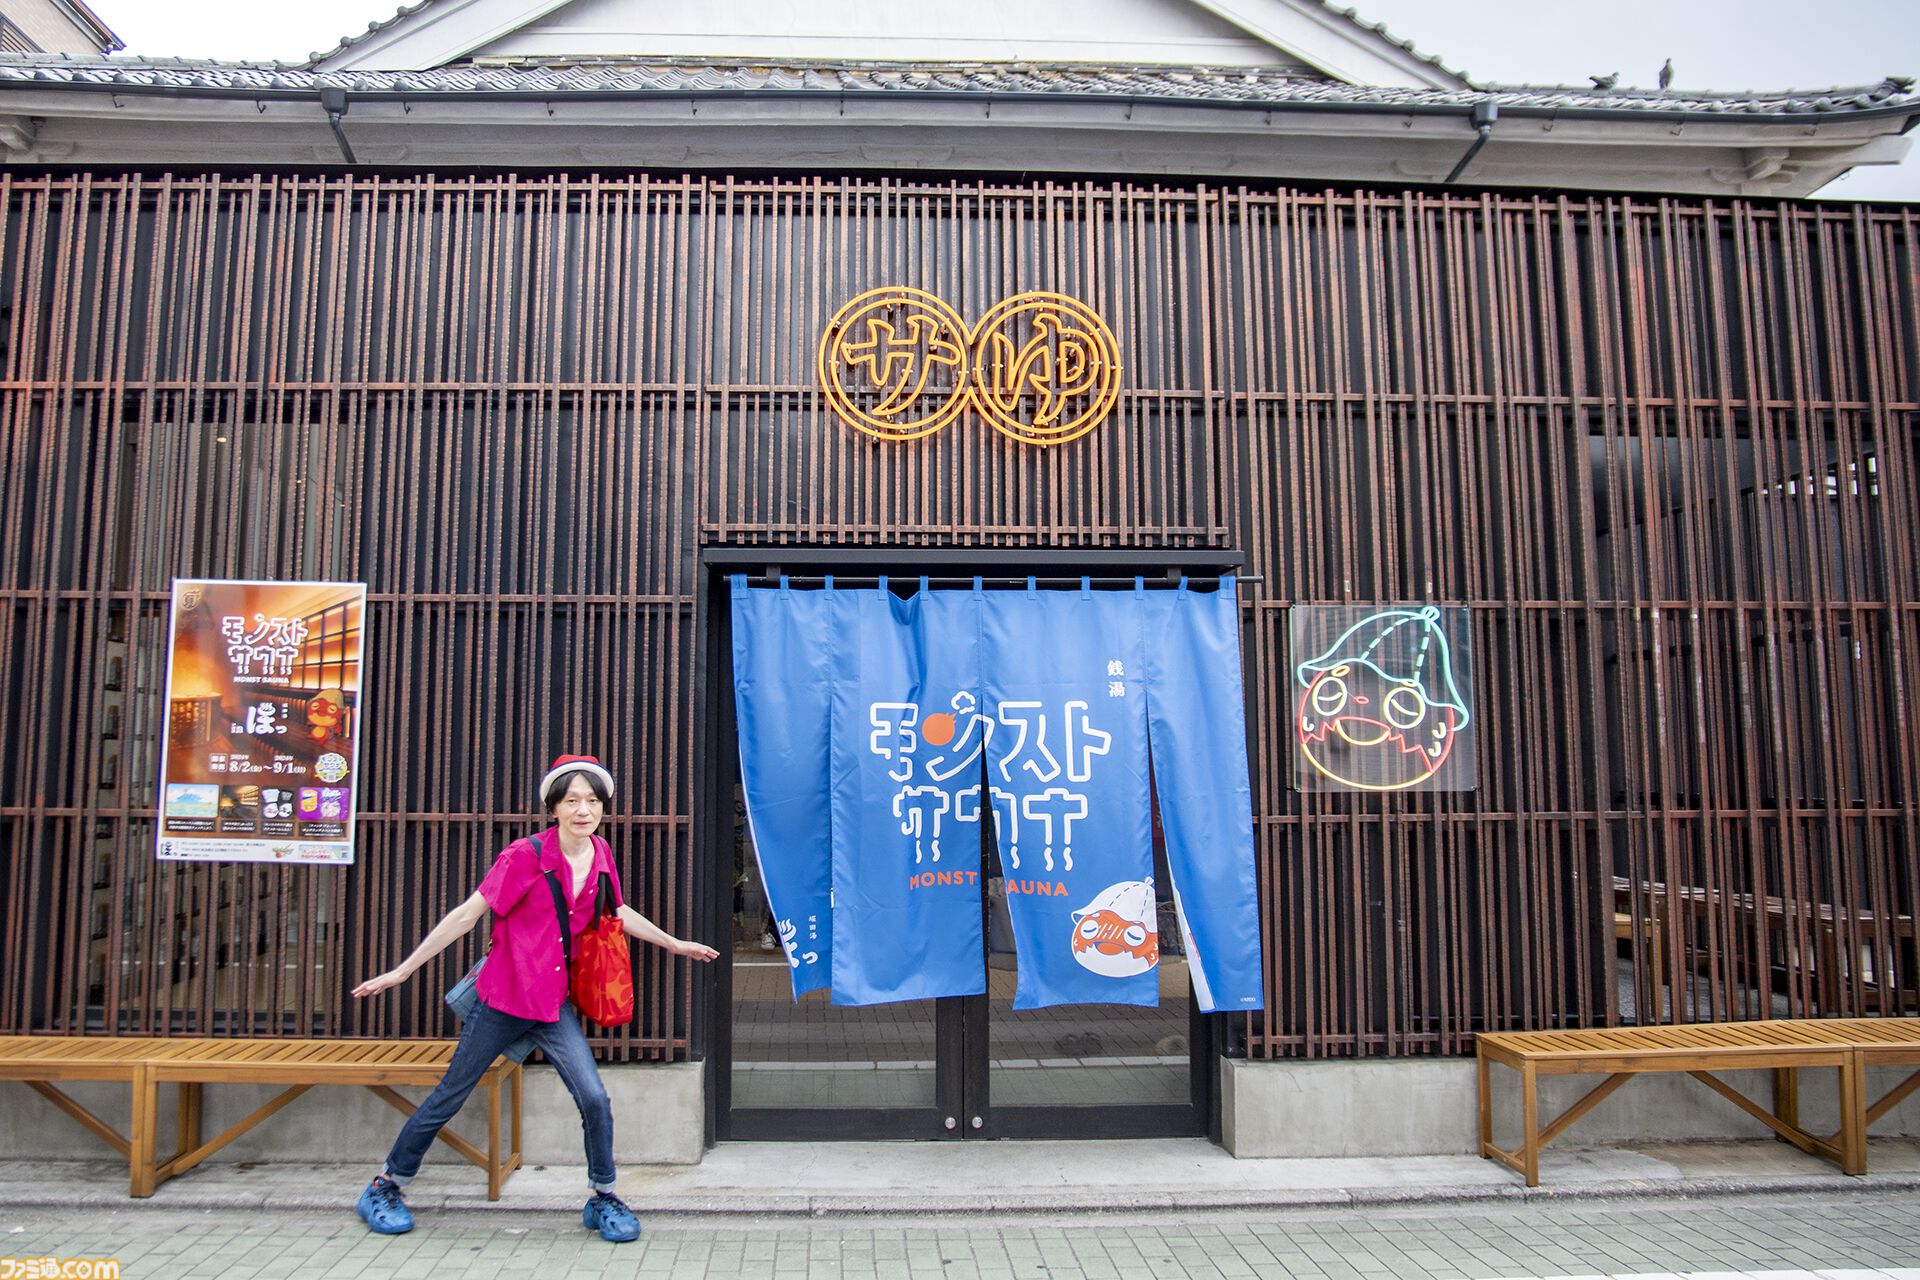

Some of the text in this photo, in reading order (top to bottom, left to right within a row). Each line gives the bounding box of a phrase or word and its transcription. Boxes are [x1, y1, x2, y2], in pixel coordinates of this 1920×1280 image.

[1107, 659, 1125, 697] 銭湯
[231, 723, 244, 734] in
[870, 691, 1112, 783] モンスト
[909, 870, 1069, 897] MONST AUNA
